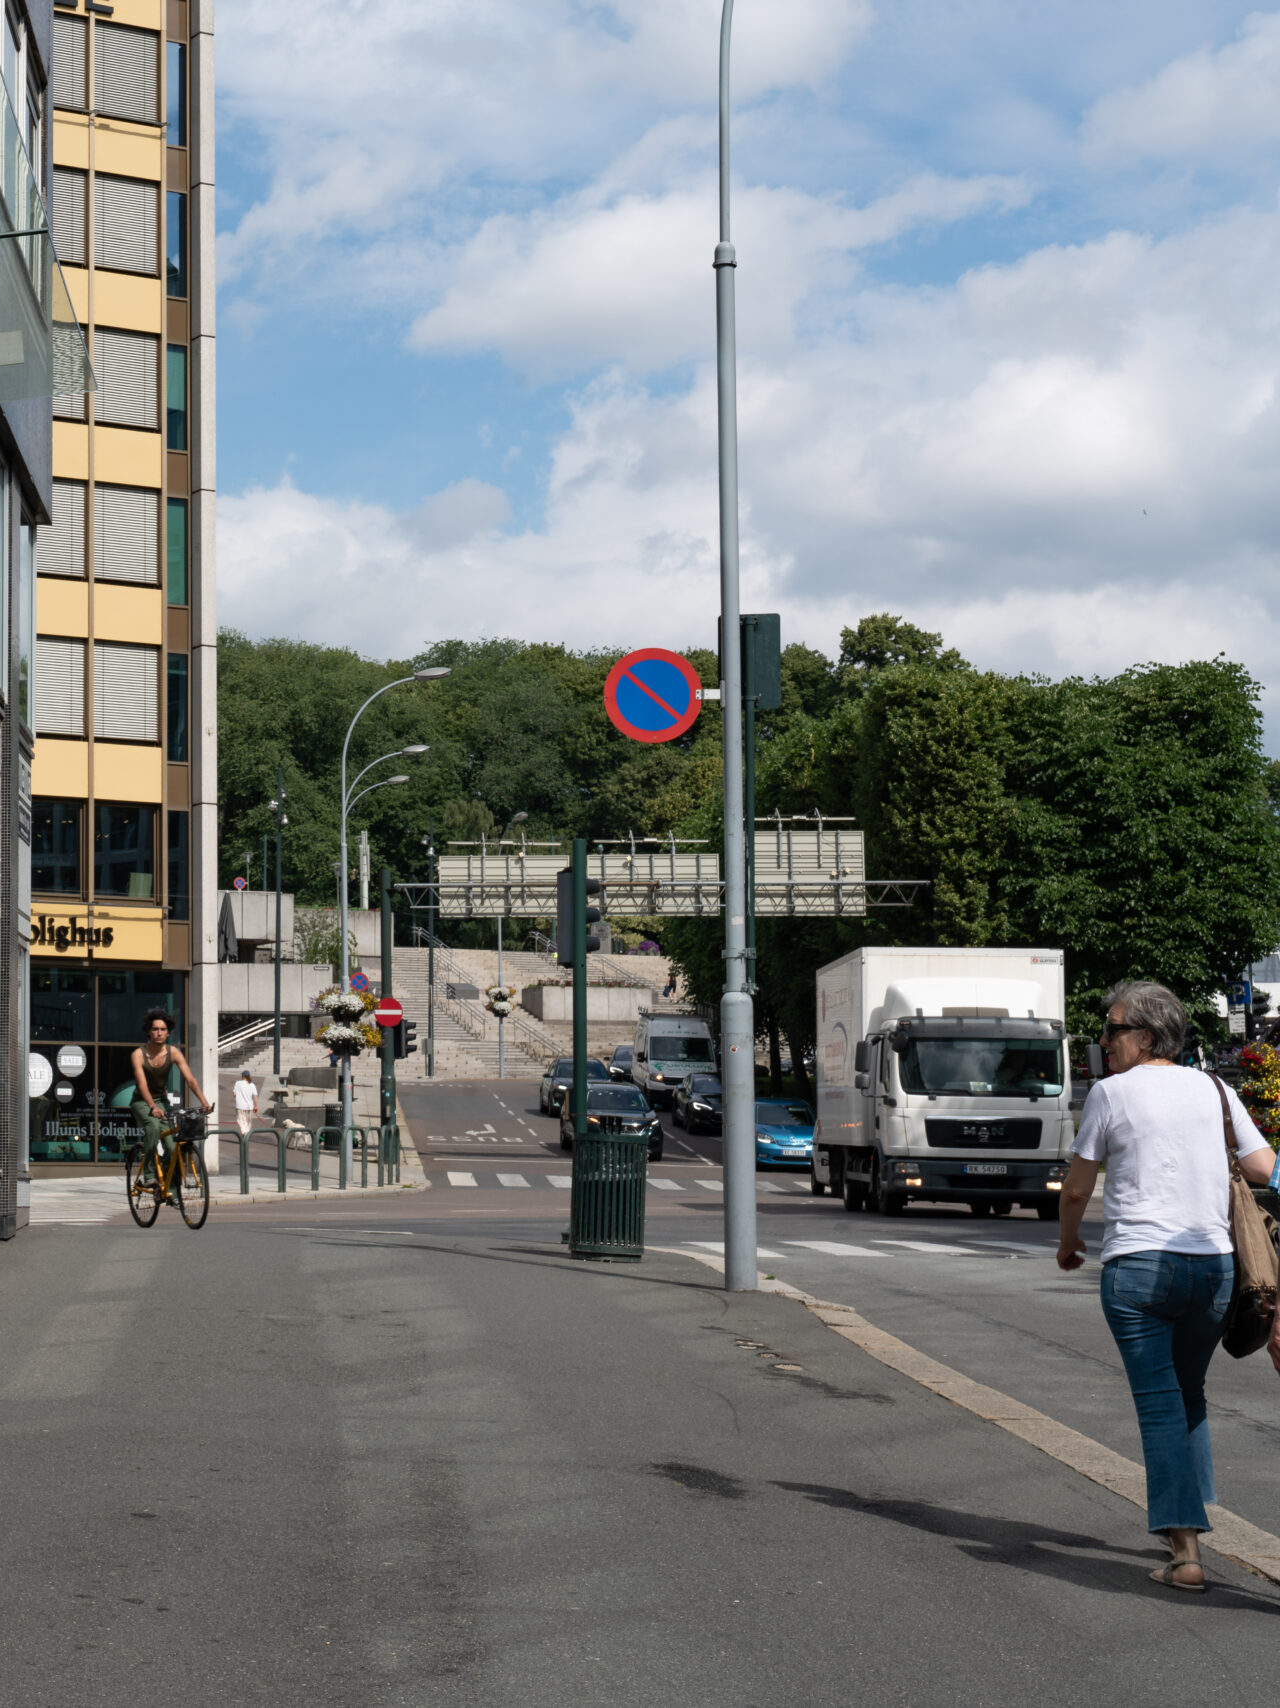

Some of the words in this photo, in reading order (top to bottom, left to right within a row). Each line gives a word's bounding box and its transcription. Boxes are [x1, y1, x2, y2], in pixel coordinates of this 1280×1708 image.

[45, 1121, 87, 1136] Illums
[89, 1121, 145, 1140] Bolighus
[963, 1126, 1004, 1136] MAN
